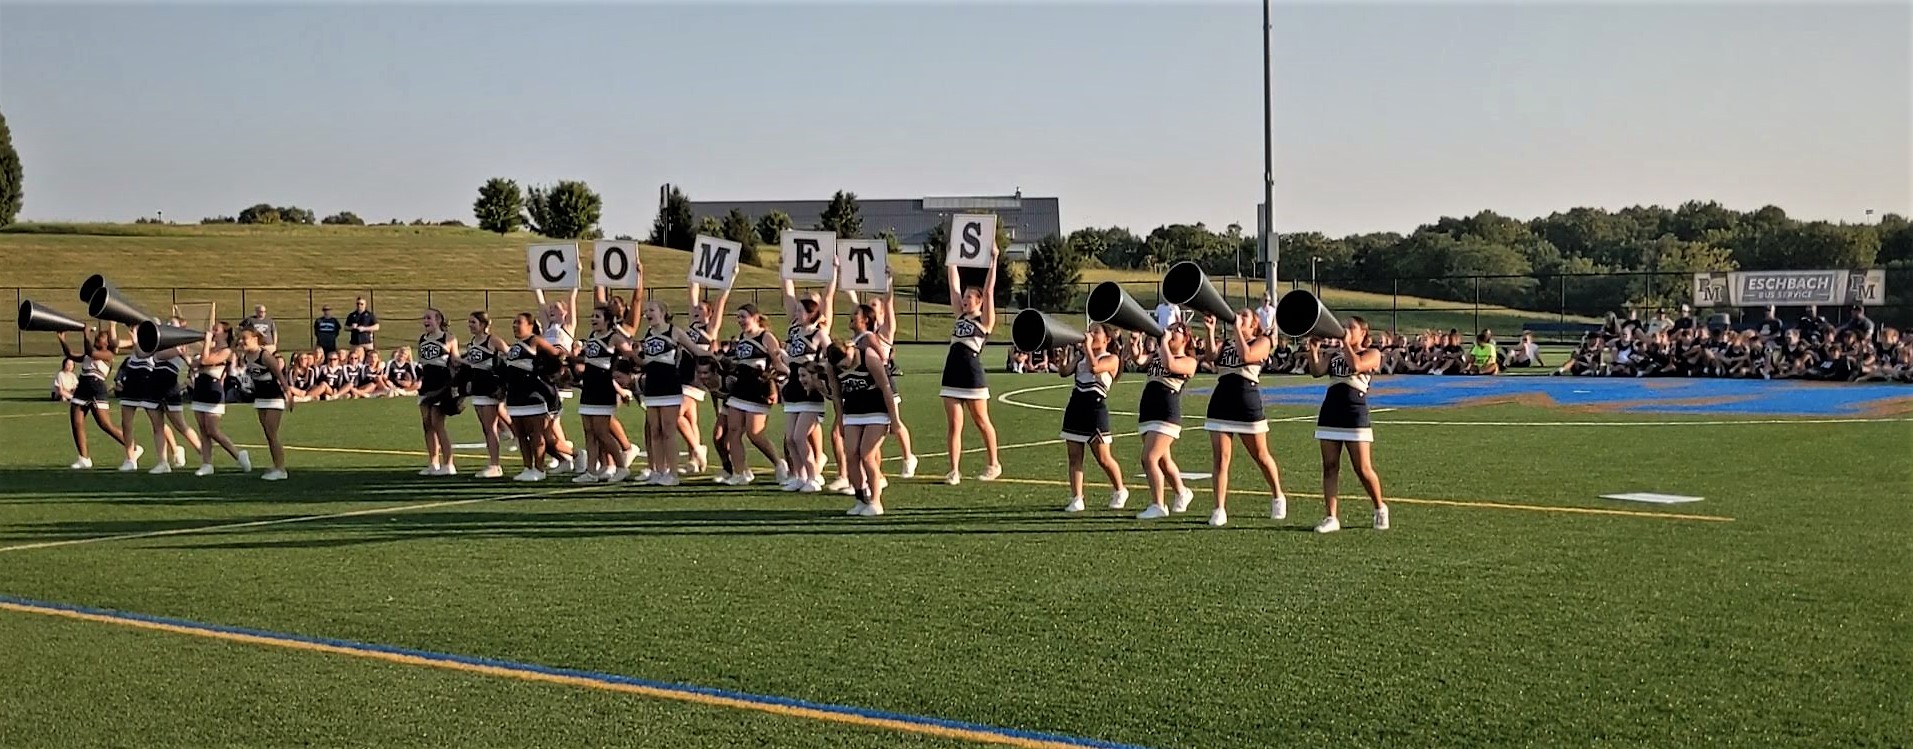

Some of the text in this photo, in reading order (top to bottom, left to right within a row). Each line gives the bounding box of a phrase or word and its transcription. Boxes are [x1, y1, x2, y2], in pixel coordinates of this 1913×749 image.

[793, 239, 821, 274] E
[960, 222, 981, 259] S
[539, 250, 567, 283] C
[603, 247, 628, 280] O
[695, 243, 730, 281] M
[849, 247, 874, 284] T
[1748, 276, 1829, 290] ESCHBACH
[1758, 290, 1813, 299] BUS SERVICE
